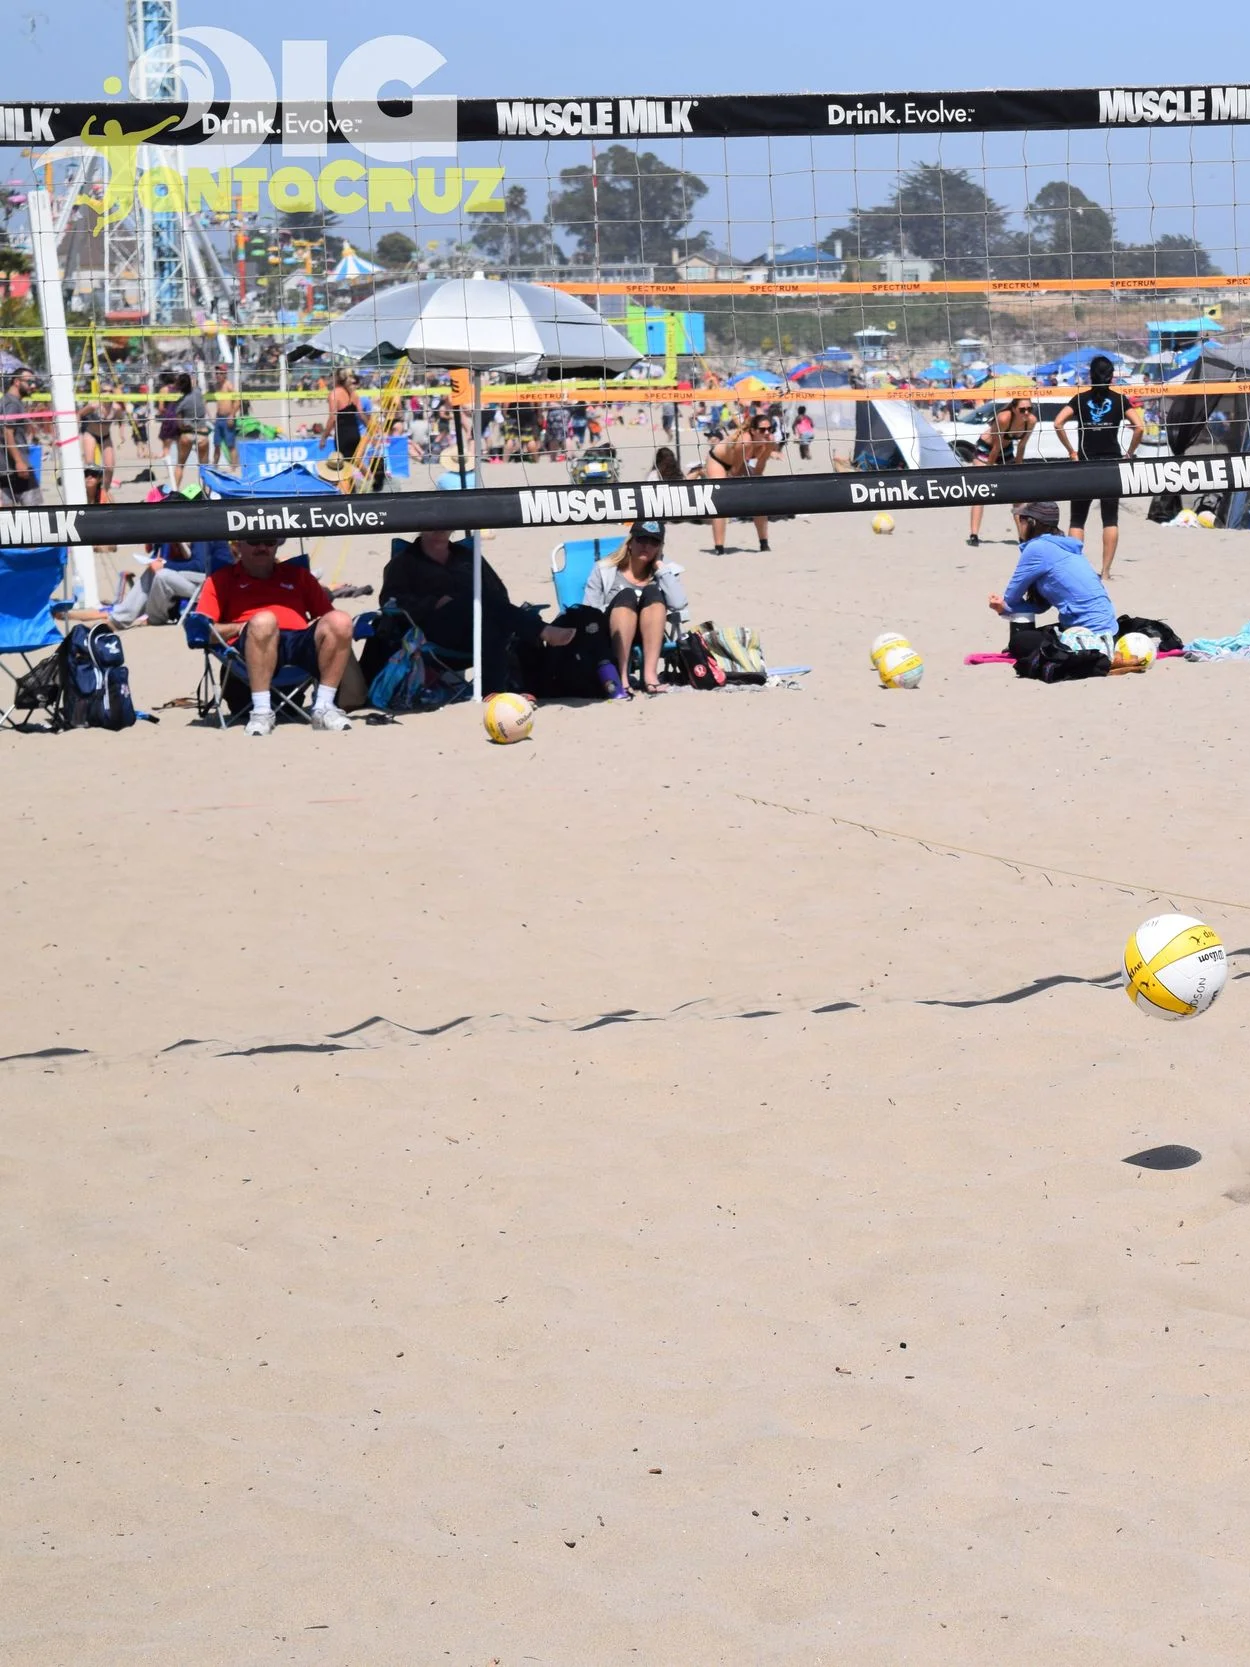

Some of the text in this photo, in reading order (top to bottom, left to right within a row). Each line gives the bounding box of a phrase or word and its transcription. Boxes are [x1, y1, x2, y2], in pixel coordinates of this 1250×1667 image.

[496, 98, 693, 135] MUSCLE MILK
[828, 102, 902, 125] Drink.
[1099, 89, 1206, 123] MUSCLE
[1123, 387, 1169, 395] SPECTRUM
[266, 447, 308, 463] BUD
[850, 480, 924, 503] Drink.
[1119, 460, 1228, 494] MUSCLE
[519, 484, 718, 523] MUSCLE MILK
[0, 510, 81, 545] MILK
[227, 506, 307, 532] Drink.
